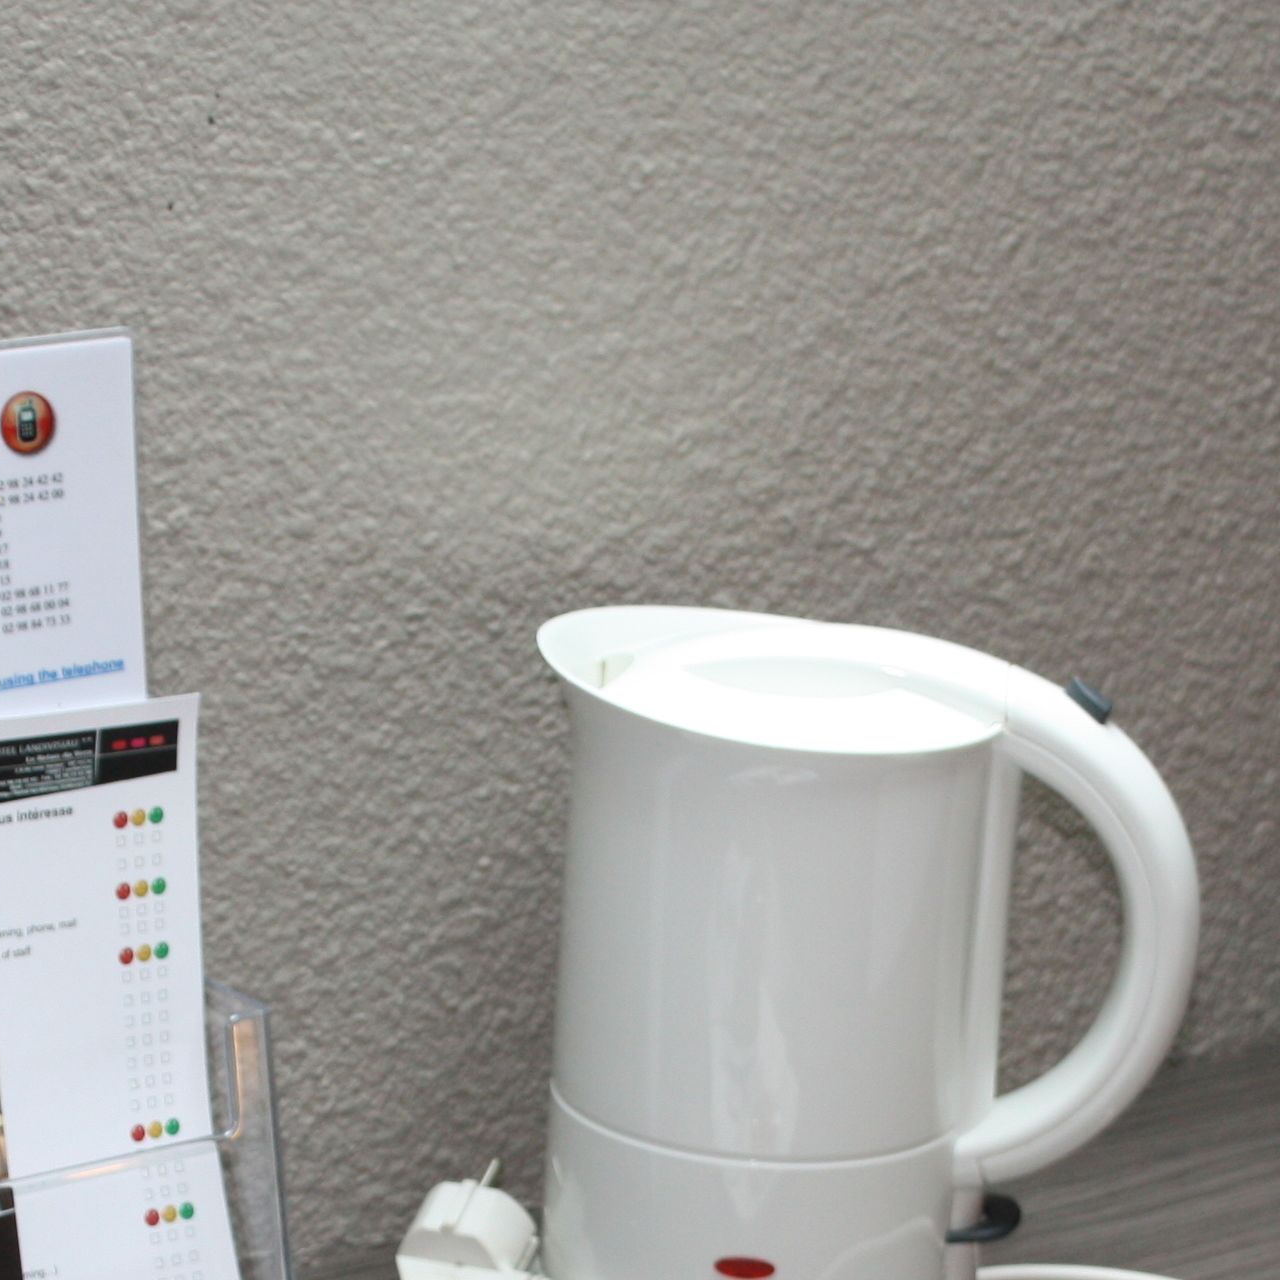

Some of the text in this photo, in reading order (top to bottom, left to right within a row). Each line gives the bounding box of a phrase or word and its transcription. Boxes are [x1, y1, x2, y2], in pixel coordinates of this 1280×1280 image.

[0, 673, 35, 690] using
[38, 668, 57, 683] the
[61, 657, 124, 680] telephone
[16, 805, 74, 823] intéresse
